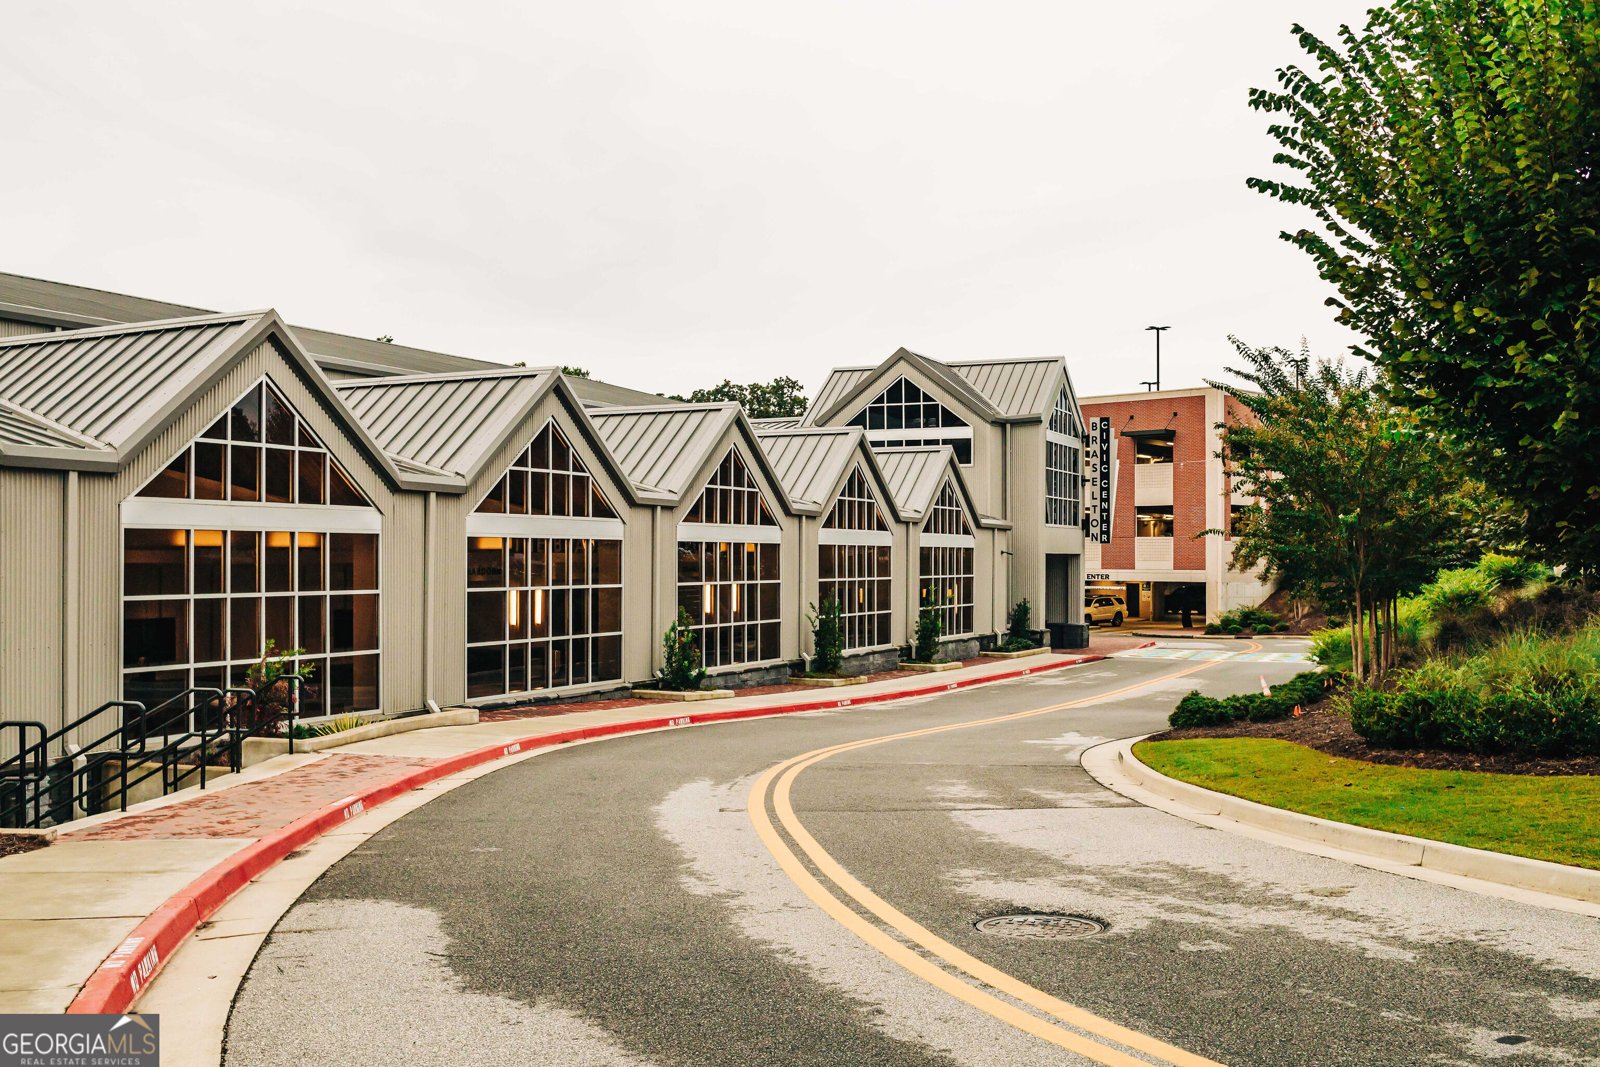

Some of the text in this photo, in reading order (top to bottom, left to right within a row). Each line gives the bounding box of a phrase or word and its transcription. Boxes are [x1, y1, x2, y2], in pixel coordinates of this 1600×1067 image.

[1091, 422, 1099, 542] BRASELTON
[1101, 422, 1109, 542] CIVIC CENTER
[130, 944, 159, 994] NO PARKING
